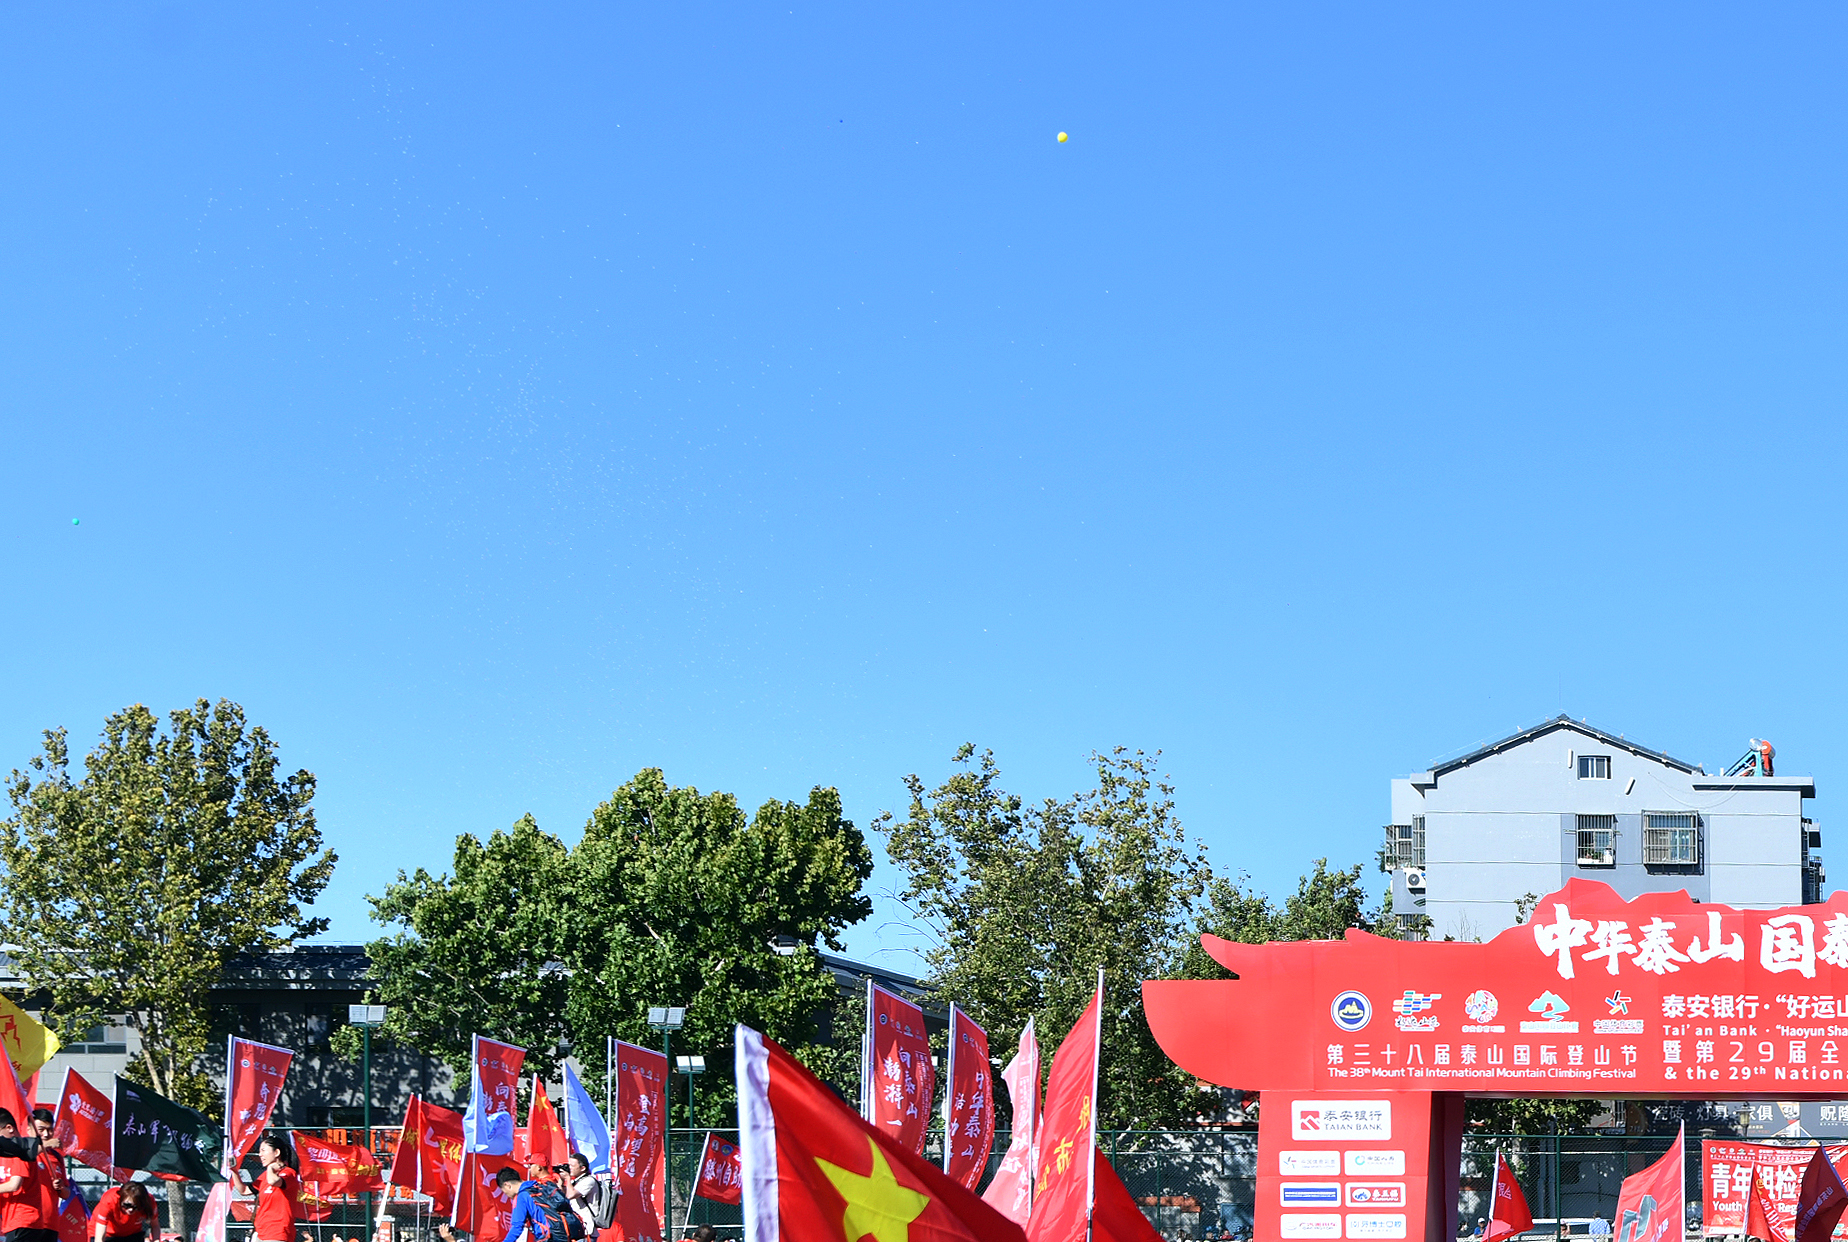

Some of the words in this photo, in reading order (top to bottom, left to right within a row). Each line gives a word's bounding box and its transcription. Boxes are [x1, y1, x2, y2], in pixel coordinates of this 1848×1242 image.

[1534, 903, 1745, 979] 中华泰山
[1719, 1024, 1757, 1036] Bank
[1327, 1044, 1637, 1066] 第三十八届泰山国际登山节
[1328, 1068, 1348, 1078] The
[1350, 1068, 1371, 1078] 38th
[1372, 1068, 1404, 1078] Mount
[1407, 1068, 1423, 1078] Tai
[1426, 1068, 1495, 1078] International
[1496, 1068, 1546, 1078] Mountain
[1548, 1067, 1592, 1080] Climbing
[1593, 1068, 1637, 1079] Festival
[1687, 1067, 1720, 1080] the
[1729, 1066, 1766, 1080] 29th
[1324, 1110, 1382, 1121] 泰安银行
[1712, 1201, 1742, 1212] Youth
